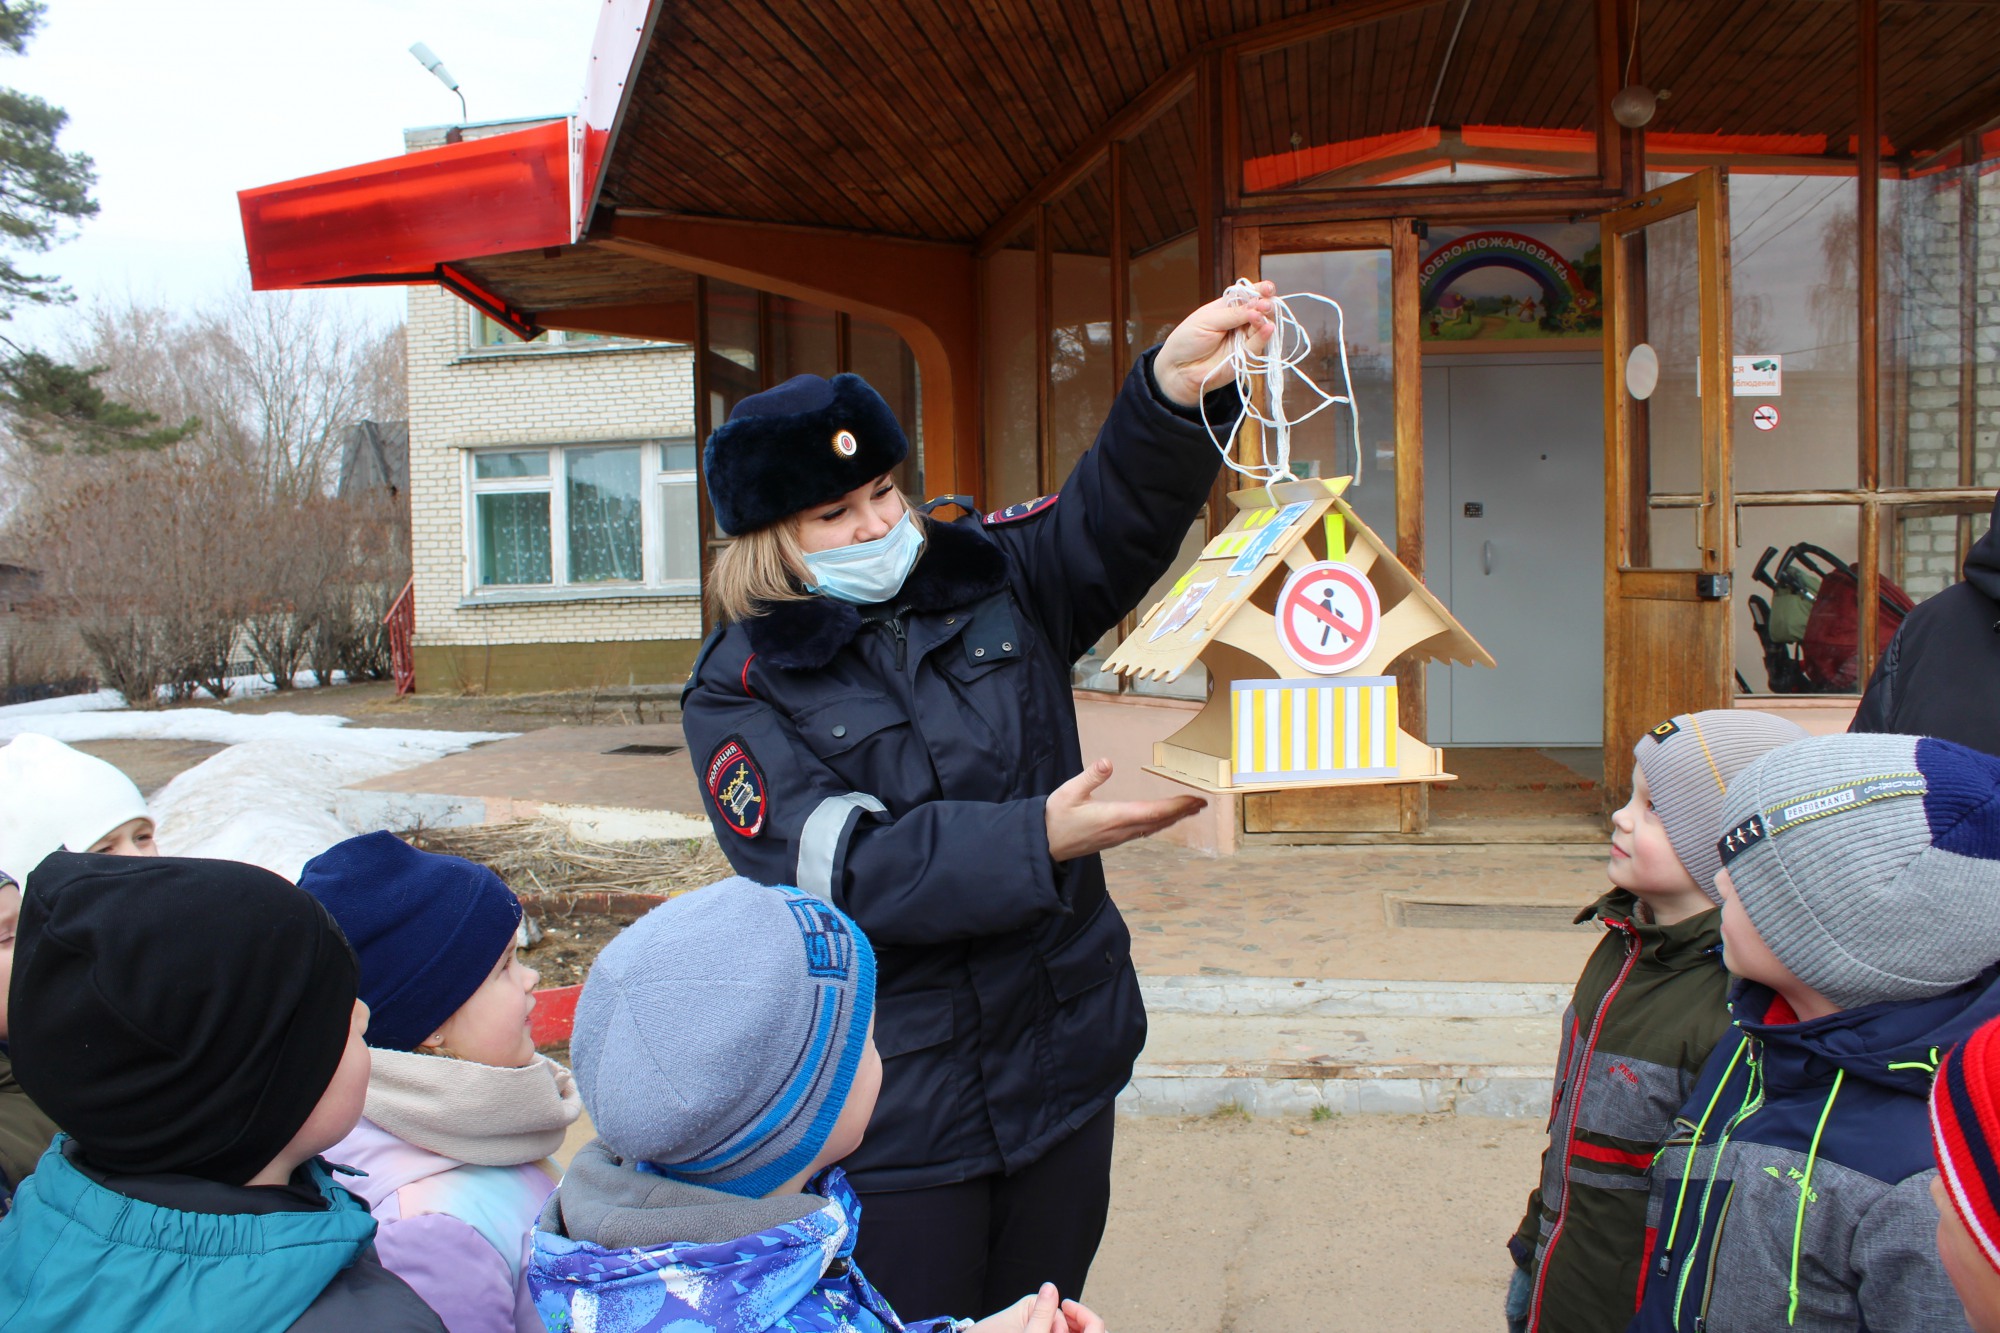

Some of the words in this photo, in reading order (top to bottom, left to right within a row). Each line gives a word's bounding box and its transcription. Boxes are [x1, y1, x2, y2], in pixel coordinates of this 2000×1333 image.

[1420, 245, 1463, 286] ДОБРО
[1465, 237, 1569, 281] ПОЖАЛОВАТЬ
[708, 745, 737, 787] ПОЛИЦИЯ
[1863, 779, 1924, 794] SPORTS
[1786, 792, 1852, 818] PERFORMANCE
